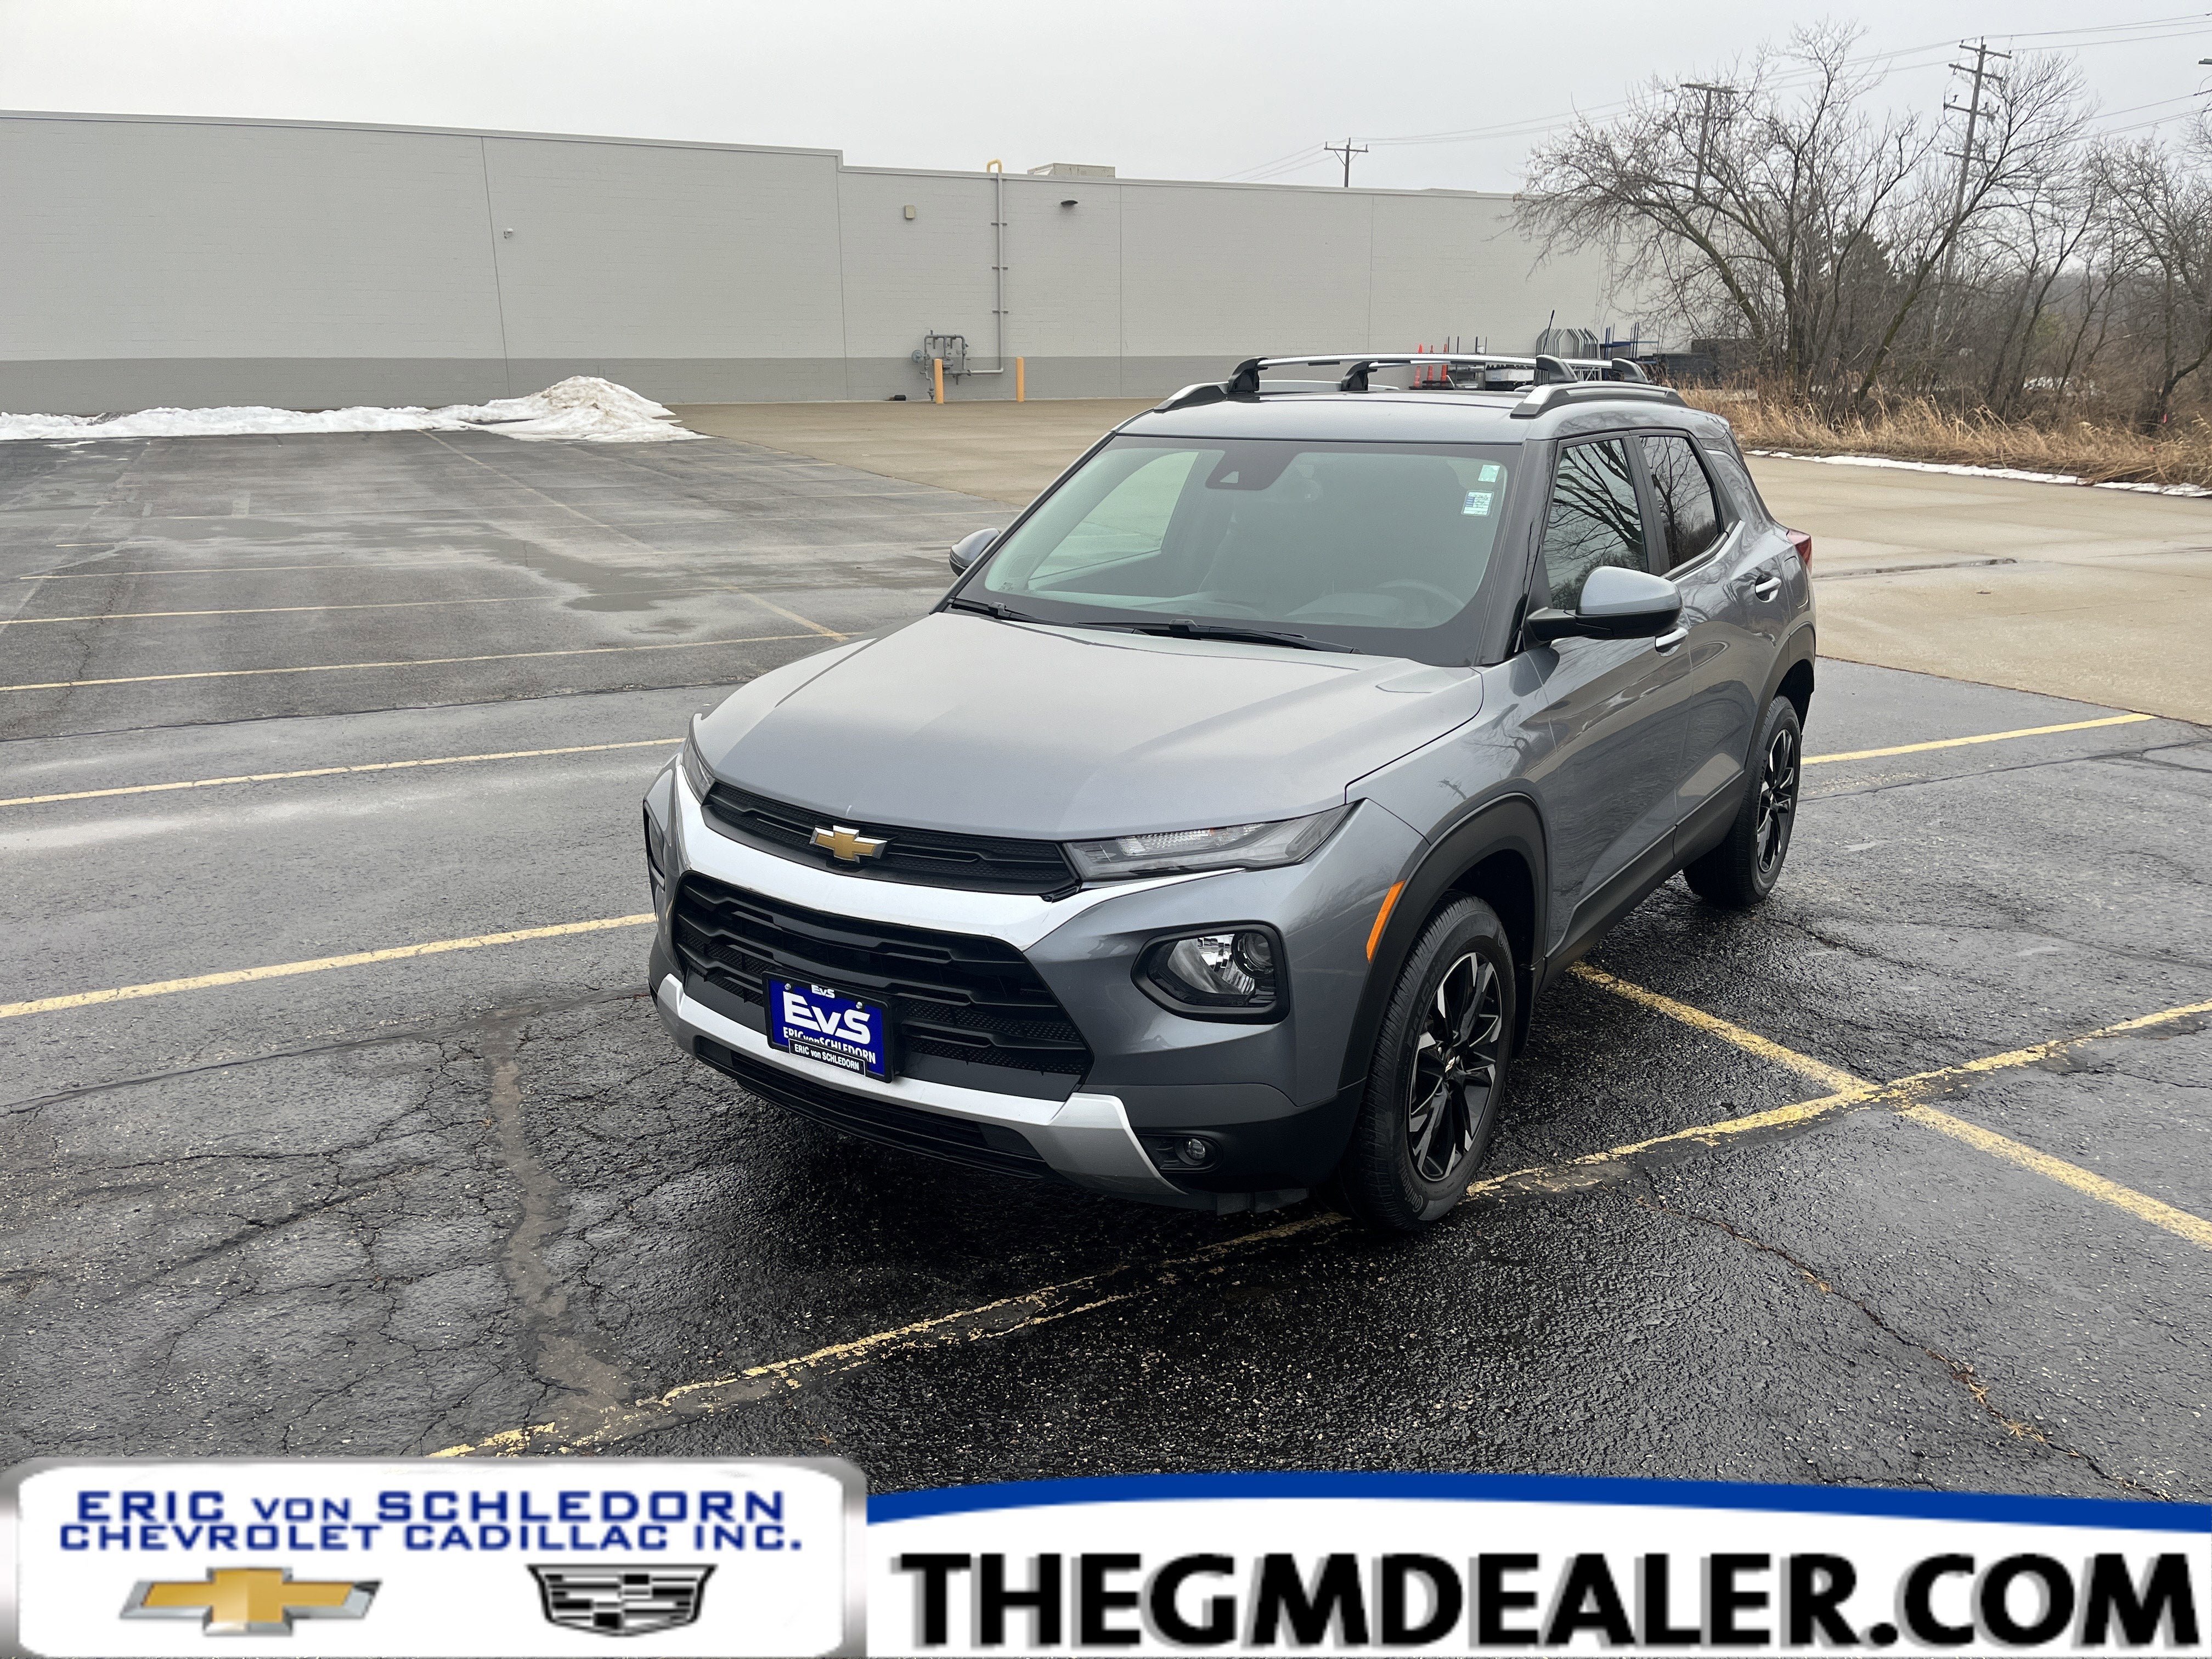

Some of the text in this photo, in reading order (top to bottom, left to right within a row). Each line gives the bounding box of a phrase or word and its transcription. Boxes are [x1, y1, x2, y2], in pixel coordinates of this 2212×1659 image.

[794, 1043, 860, 1070] ERIC von SCHLEDORN
